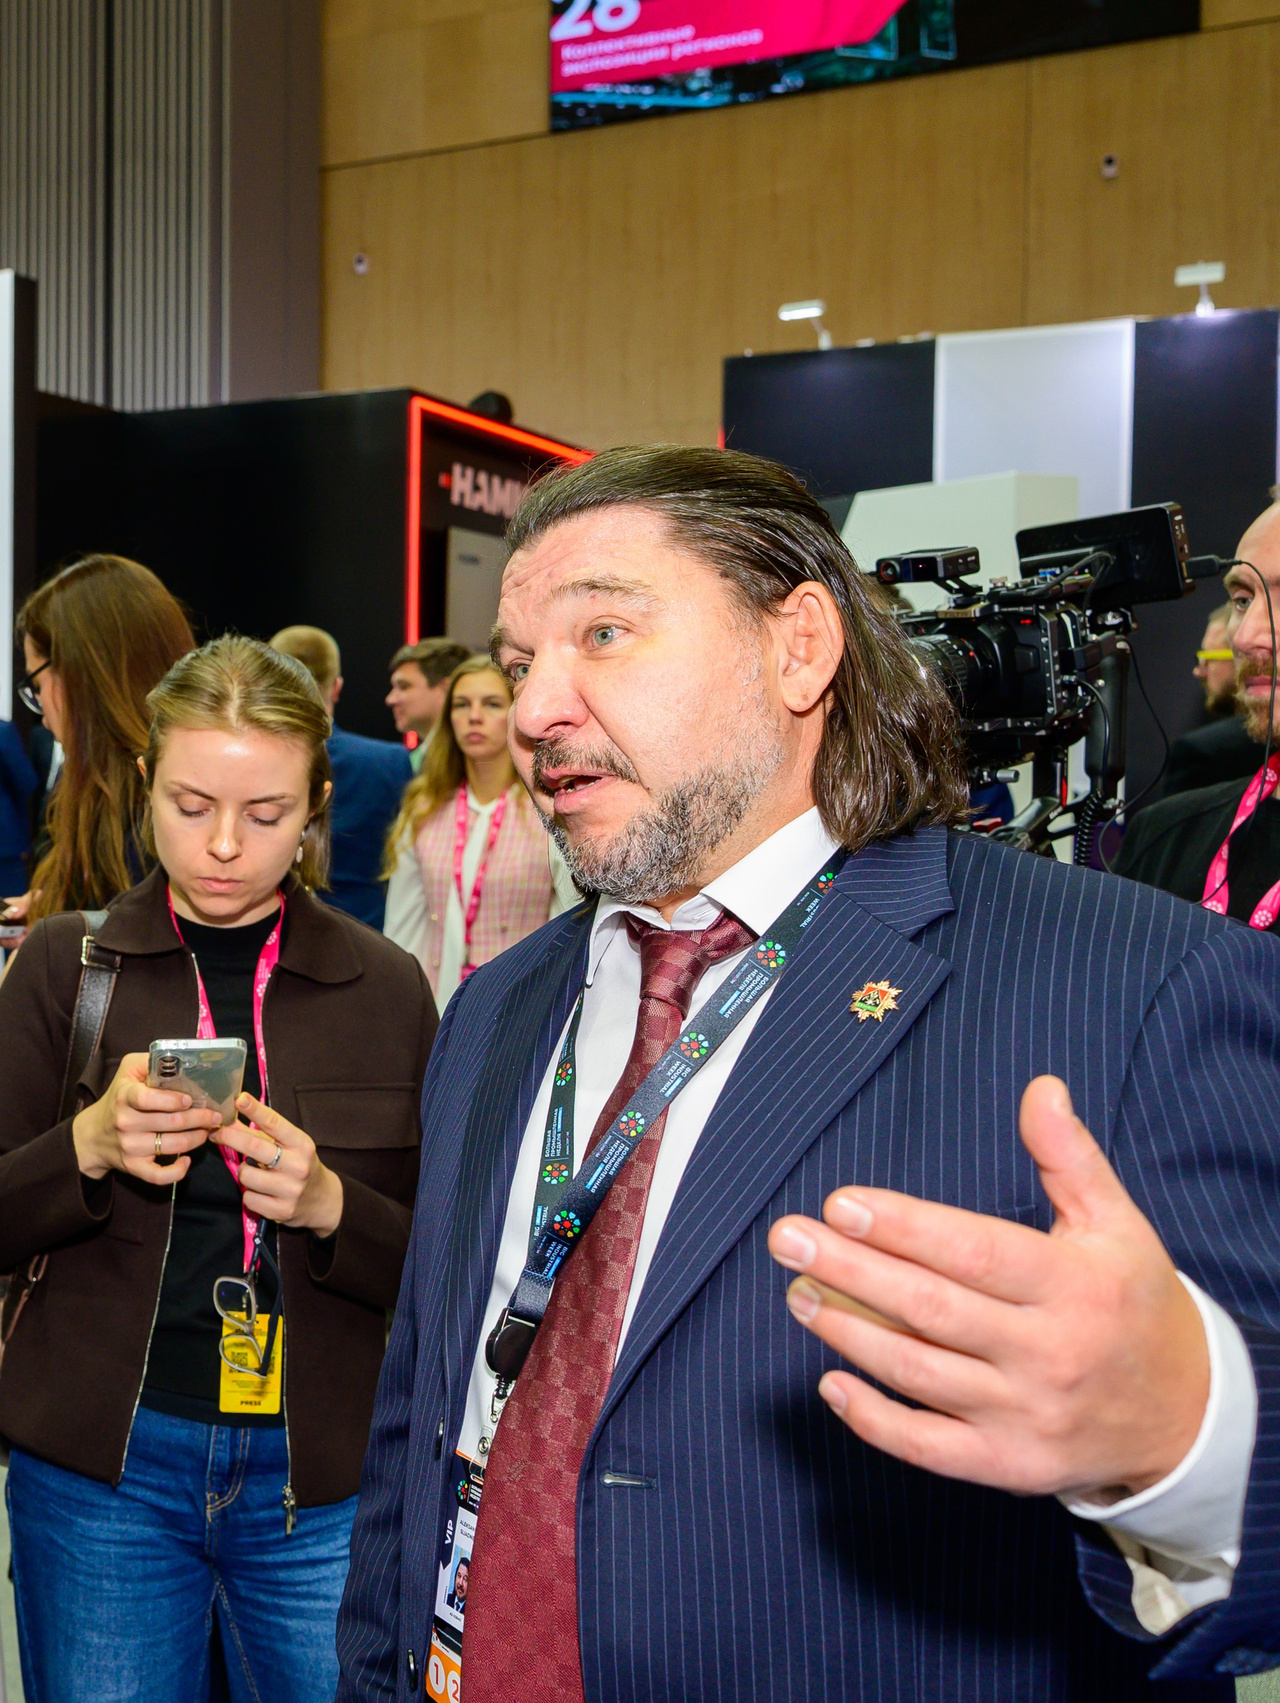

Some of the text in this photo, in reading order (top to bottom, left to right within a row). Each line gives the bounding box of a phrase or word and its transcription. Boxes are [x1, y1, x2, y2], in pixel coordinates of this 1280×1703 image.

[805, 898, 821, 913] WEEK
[738, 968, 759, 991] НЕДЕЛЯ
[744, 976, 769, 1004] БОЛЬШАЯ
[723, 972, 764, 1019] ПРОМЫШЛЕННАЯ
[660, 1063, 687, 1093] INDUSTRIAL
[666, 1060, 682, 1076] WEEK
[681, 1066, 692, 1078] BIG
[602, 1139, 621, 1164] НЕДЕЛЯ
[608, 1146, 630, 1176] БОЛЬШАЯ
[590, 1142, 625, 1194] ПРОМЫШЛЕННАЯ
[541, 1243, 563, 1276] INDUSTRIAL
[544, 1241, 558, 1258] WEEK
[559, 1246, 569, 1257] BIG
[444, 1519, 454, 1545] VIP
[433, 1661, 460, 1703] 1 2
